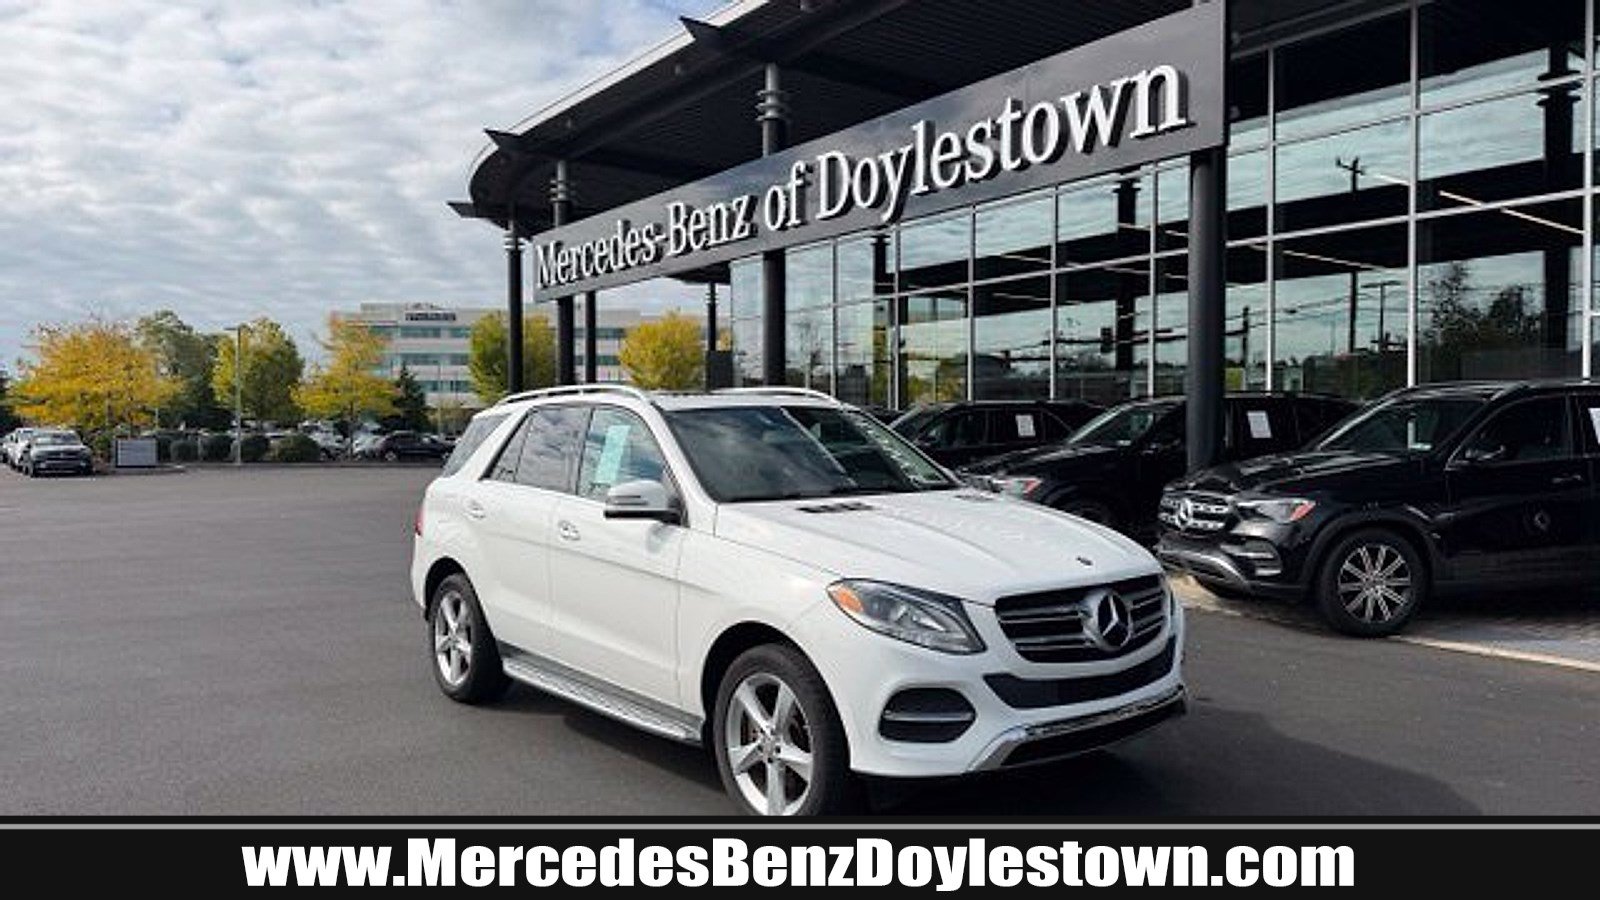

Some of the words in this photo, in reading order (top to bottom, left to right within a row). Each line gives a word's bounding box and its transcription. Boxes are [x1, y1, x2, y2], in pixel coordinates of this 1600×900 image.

[535, 195, 754, 287] Mercedes-Benz
[764, 161, 810, 231] of
[817, 64, 1189, 222] Doylestown
